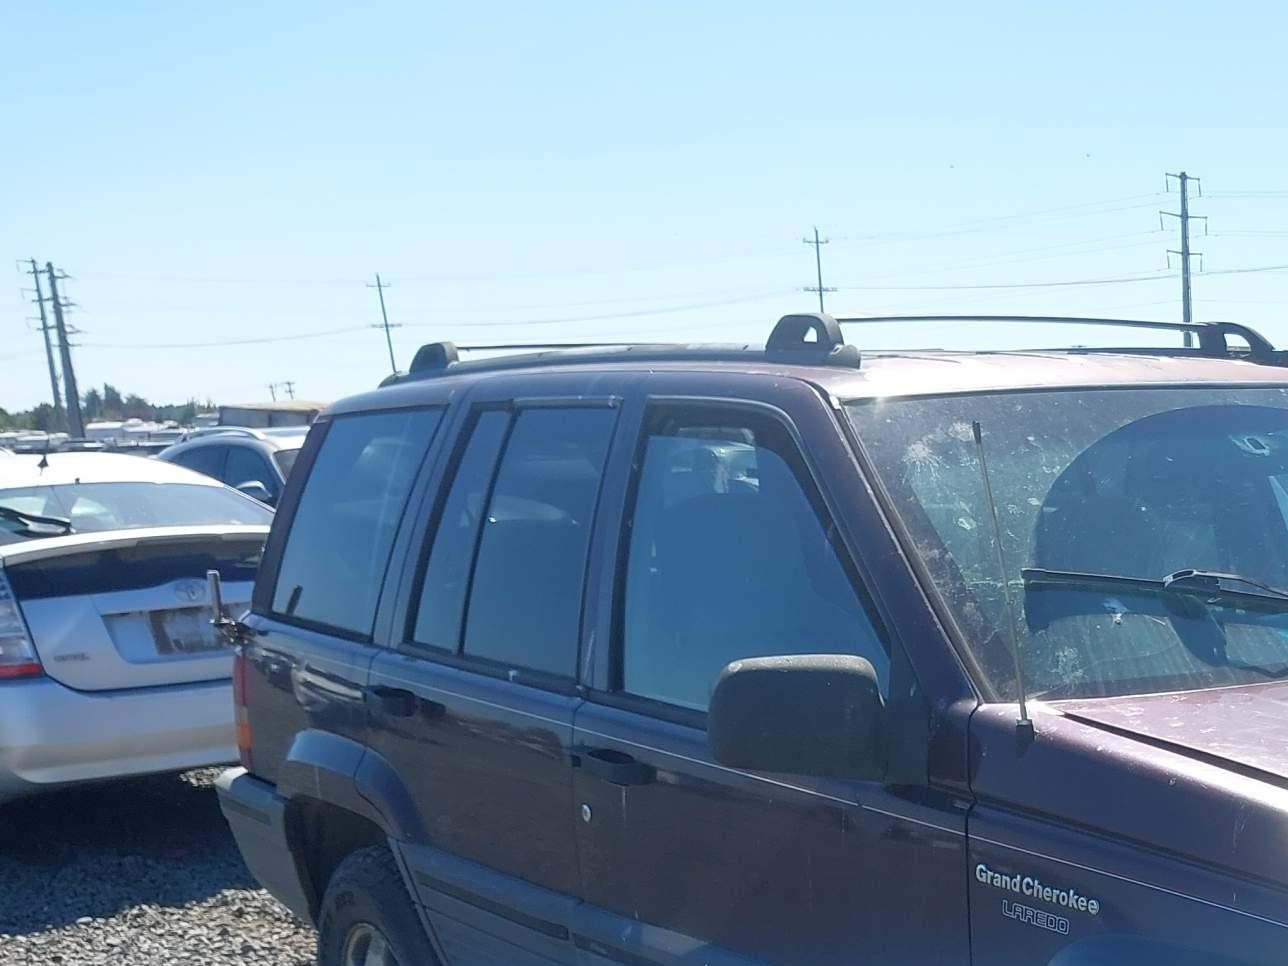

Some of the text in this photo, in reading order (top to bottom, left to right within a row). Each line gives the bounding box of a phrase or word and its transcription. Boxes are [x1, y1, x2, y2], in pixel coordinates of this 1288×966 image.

[975, 863, 1100, 915] Grand Cherokee
[1002, 900, 1070, 935] LAREDO
